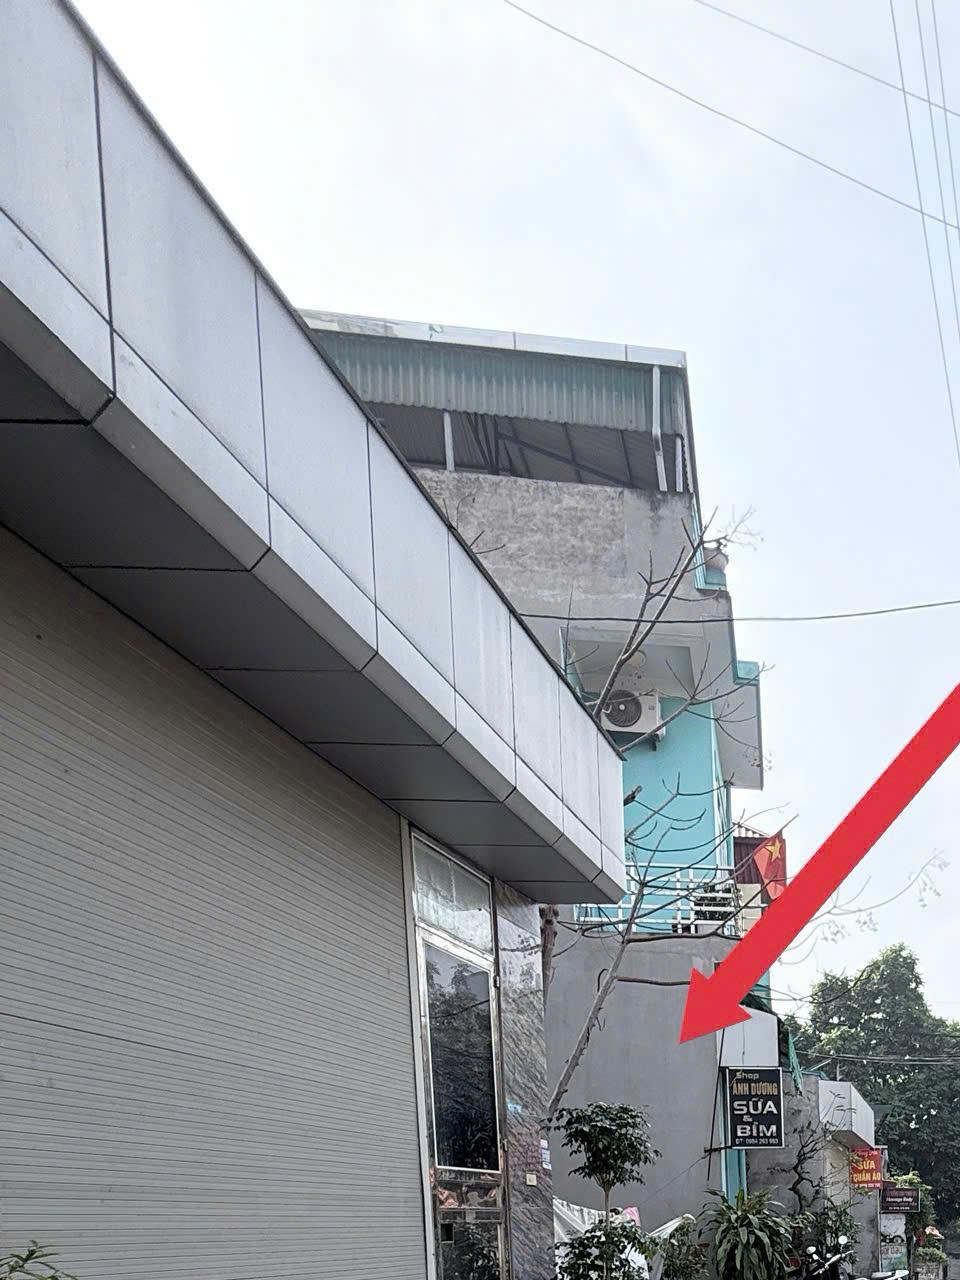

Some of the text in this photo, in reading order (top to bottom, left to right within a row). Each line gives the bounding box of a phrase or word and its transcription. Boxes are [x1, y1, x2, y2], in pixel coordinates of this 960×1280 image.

[736, 1072, 759, 1080] Shop
[751, 1081, 778, 1095] DƯƠNG
[733, 1097, 778, 1114] SỮA
